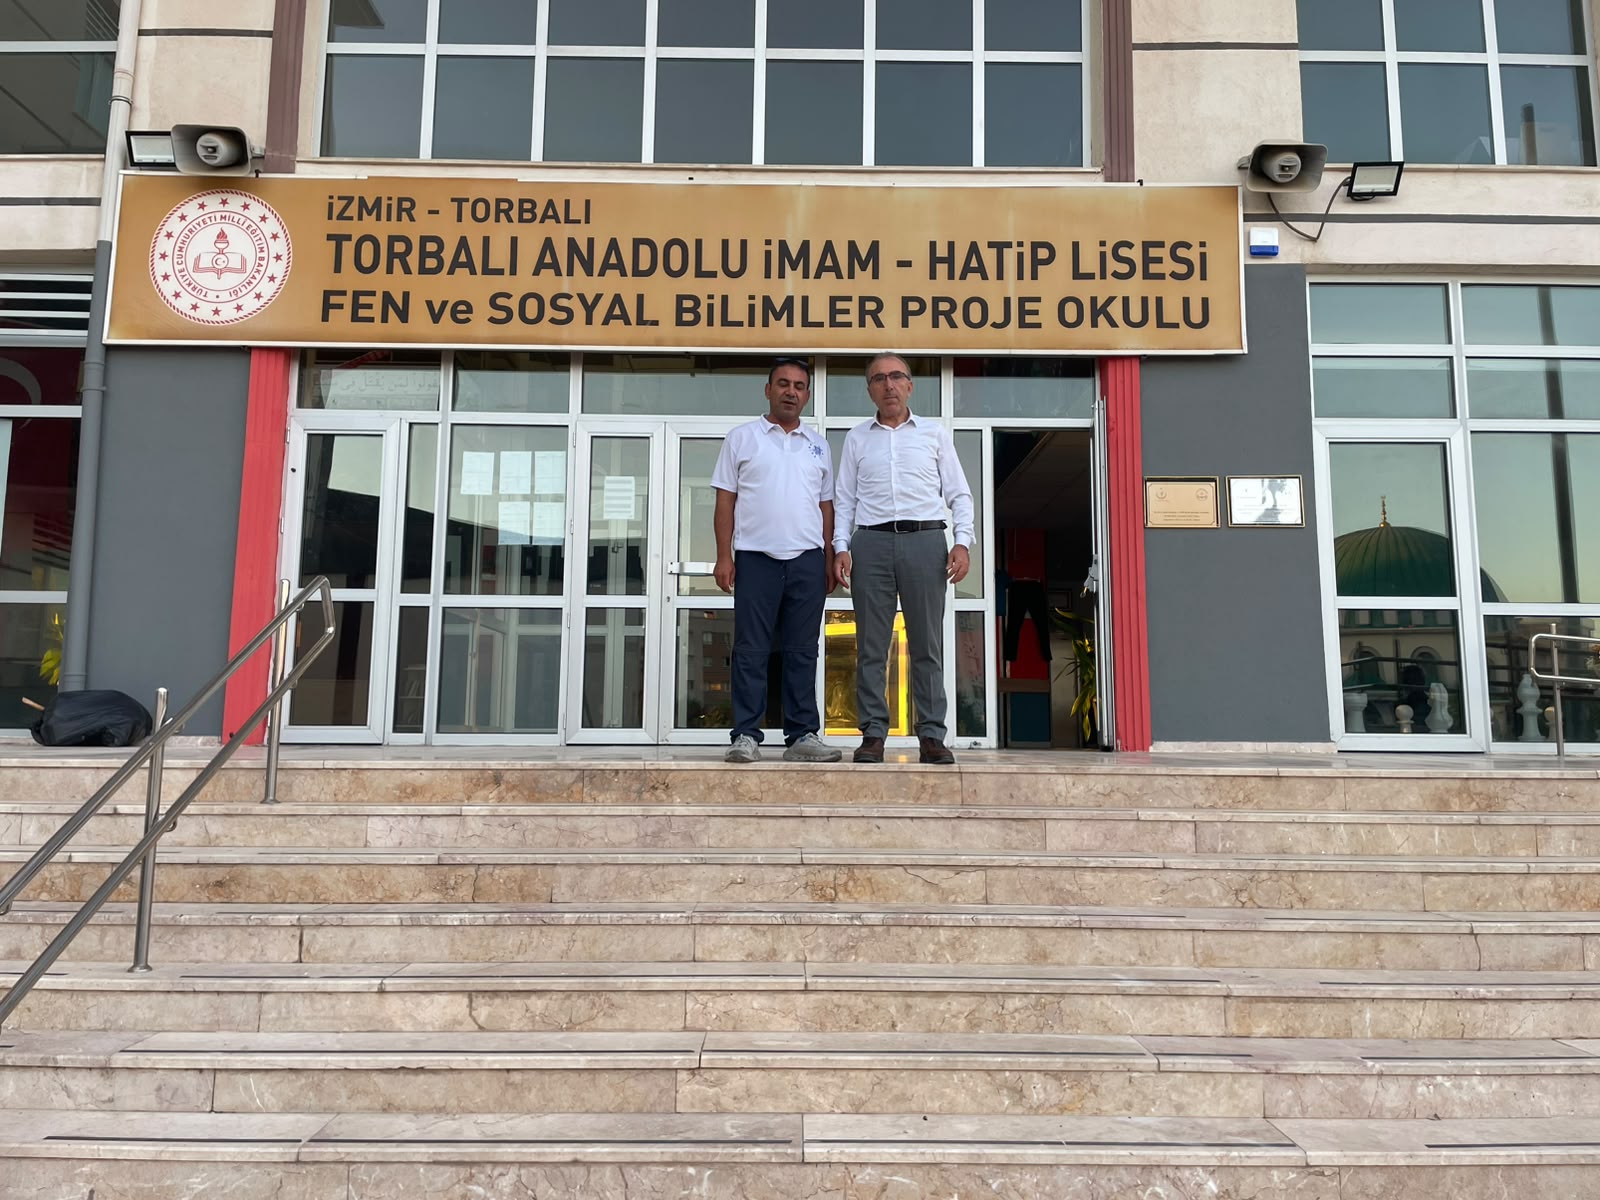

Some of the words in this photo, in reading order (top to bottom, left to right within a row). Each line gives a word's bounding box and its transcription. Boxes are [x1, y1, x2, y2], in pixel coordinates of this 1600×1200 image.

[450, 197, 591, 225] TORBALI
[325, 233, 519, 276] TORBALI
[531, 236, 748, 279] ANADOLU
[320, 289, 411, 324] FEN
[424, 299, 474, 325] ve
[487, 291, 660, 327] SOSYAL
[901, 295, 1043, 330] PROJE
[1057, 295, 1210, 330] OKULU
